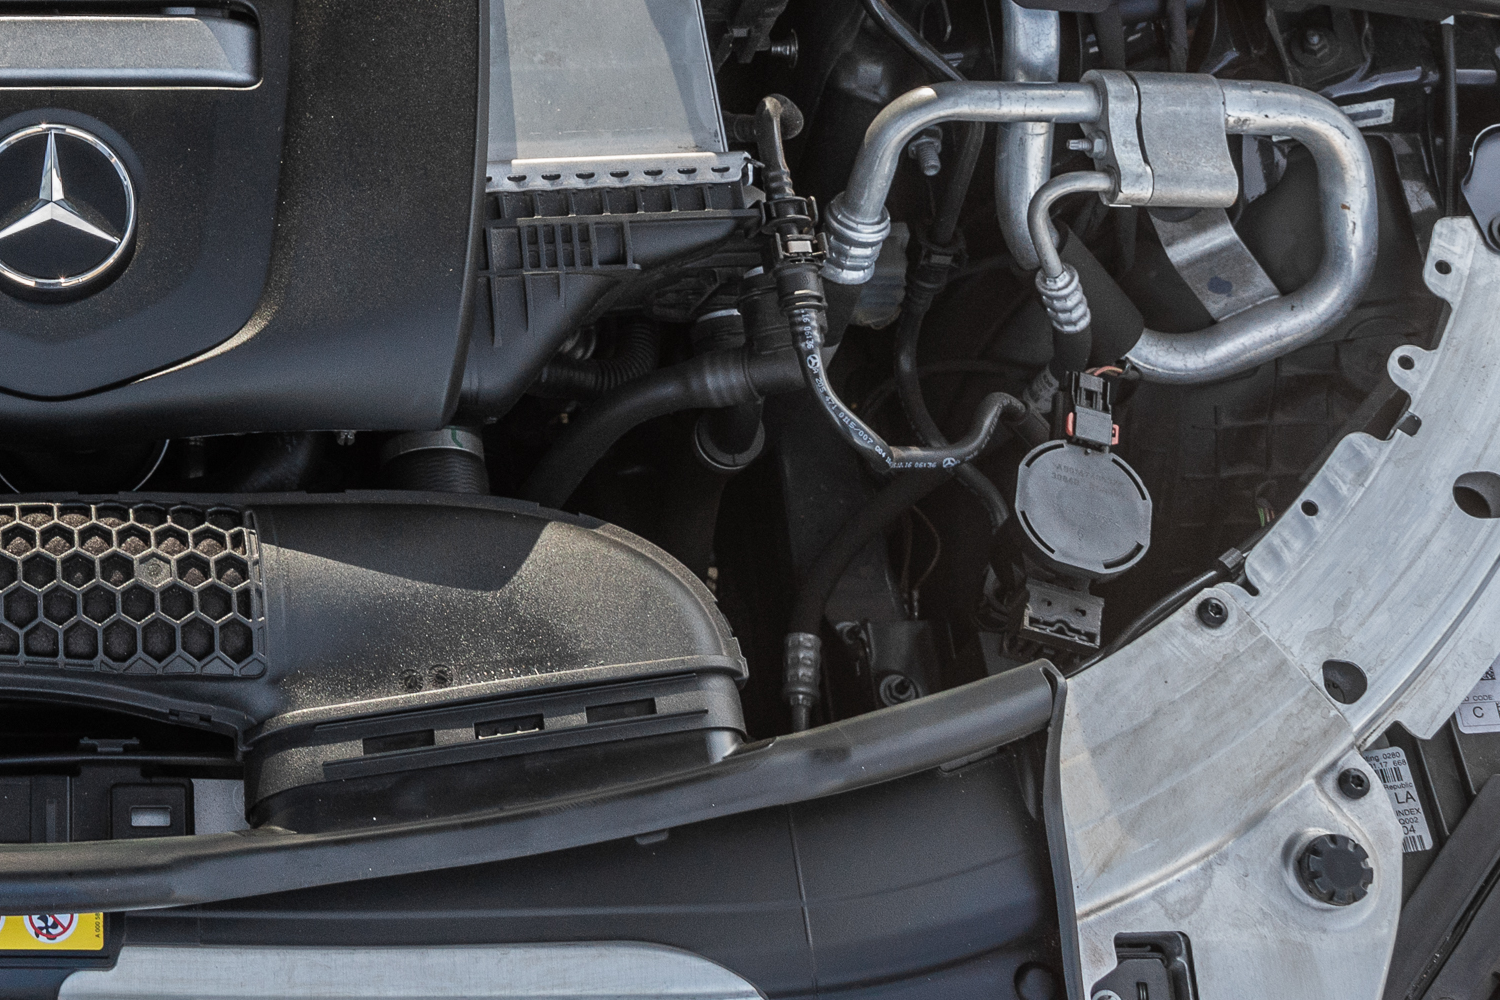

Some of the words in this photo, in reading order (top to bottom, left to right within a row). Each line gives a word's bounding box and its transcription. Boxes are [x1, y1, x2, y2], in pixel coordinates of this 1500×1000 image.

[815, 377, 826, 393] 205
[825, 395, 838, 410] 471
[1472, 706, 1484, 718] C
[1383, 751, 1401, 759] 0280
[1384, 782, 1413, 791] Republic
[1394, 790, 1417, 804] LA
[1395, 807, 1422, 817] INDEX
